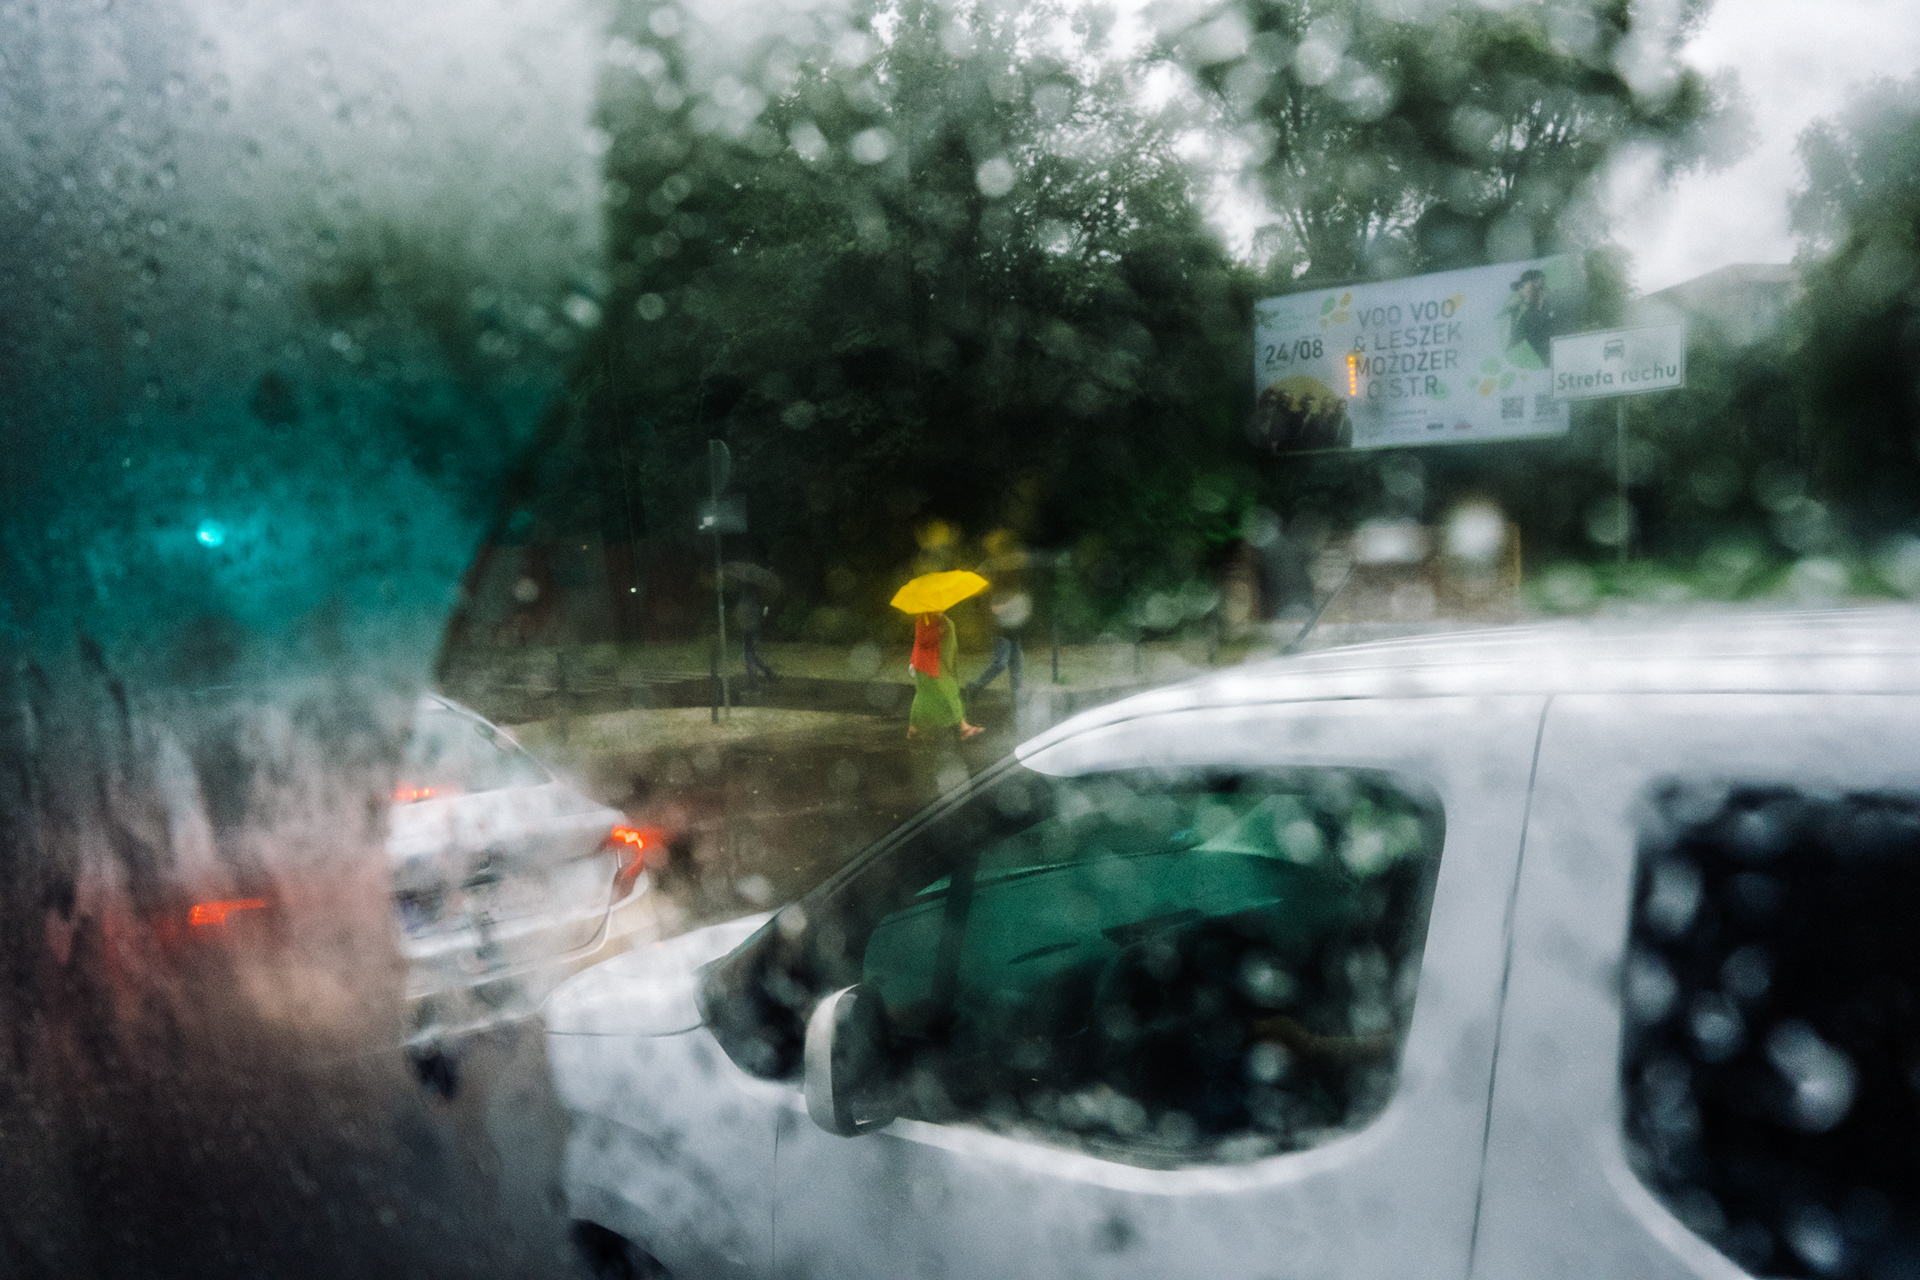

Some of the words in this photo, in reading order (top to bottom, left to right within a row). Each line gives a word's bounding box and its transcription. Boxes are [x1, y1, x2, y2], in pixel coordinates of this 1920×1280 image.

[1357, 306, 1401, 327] VOO
[1410, 299, 1455, 321] VOO
[1354, 335, 1365, 352] &
[1374, 321, 1462, 351] LESZEK
[1265, 339, 1323, 365] 24/08
[1557, 367, 1614, 390] Strefa
[1621, 362, 1676, 383] ruchu
